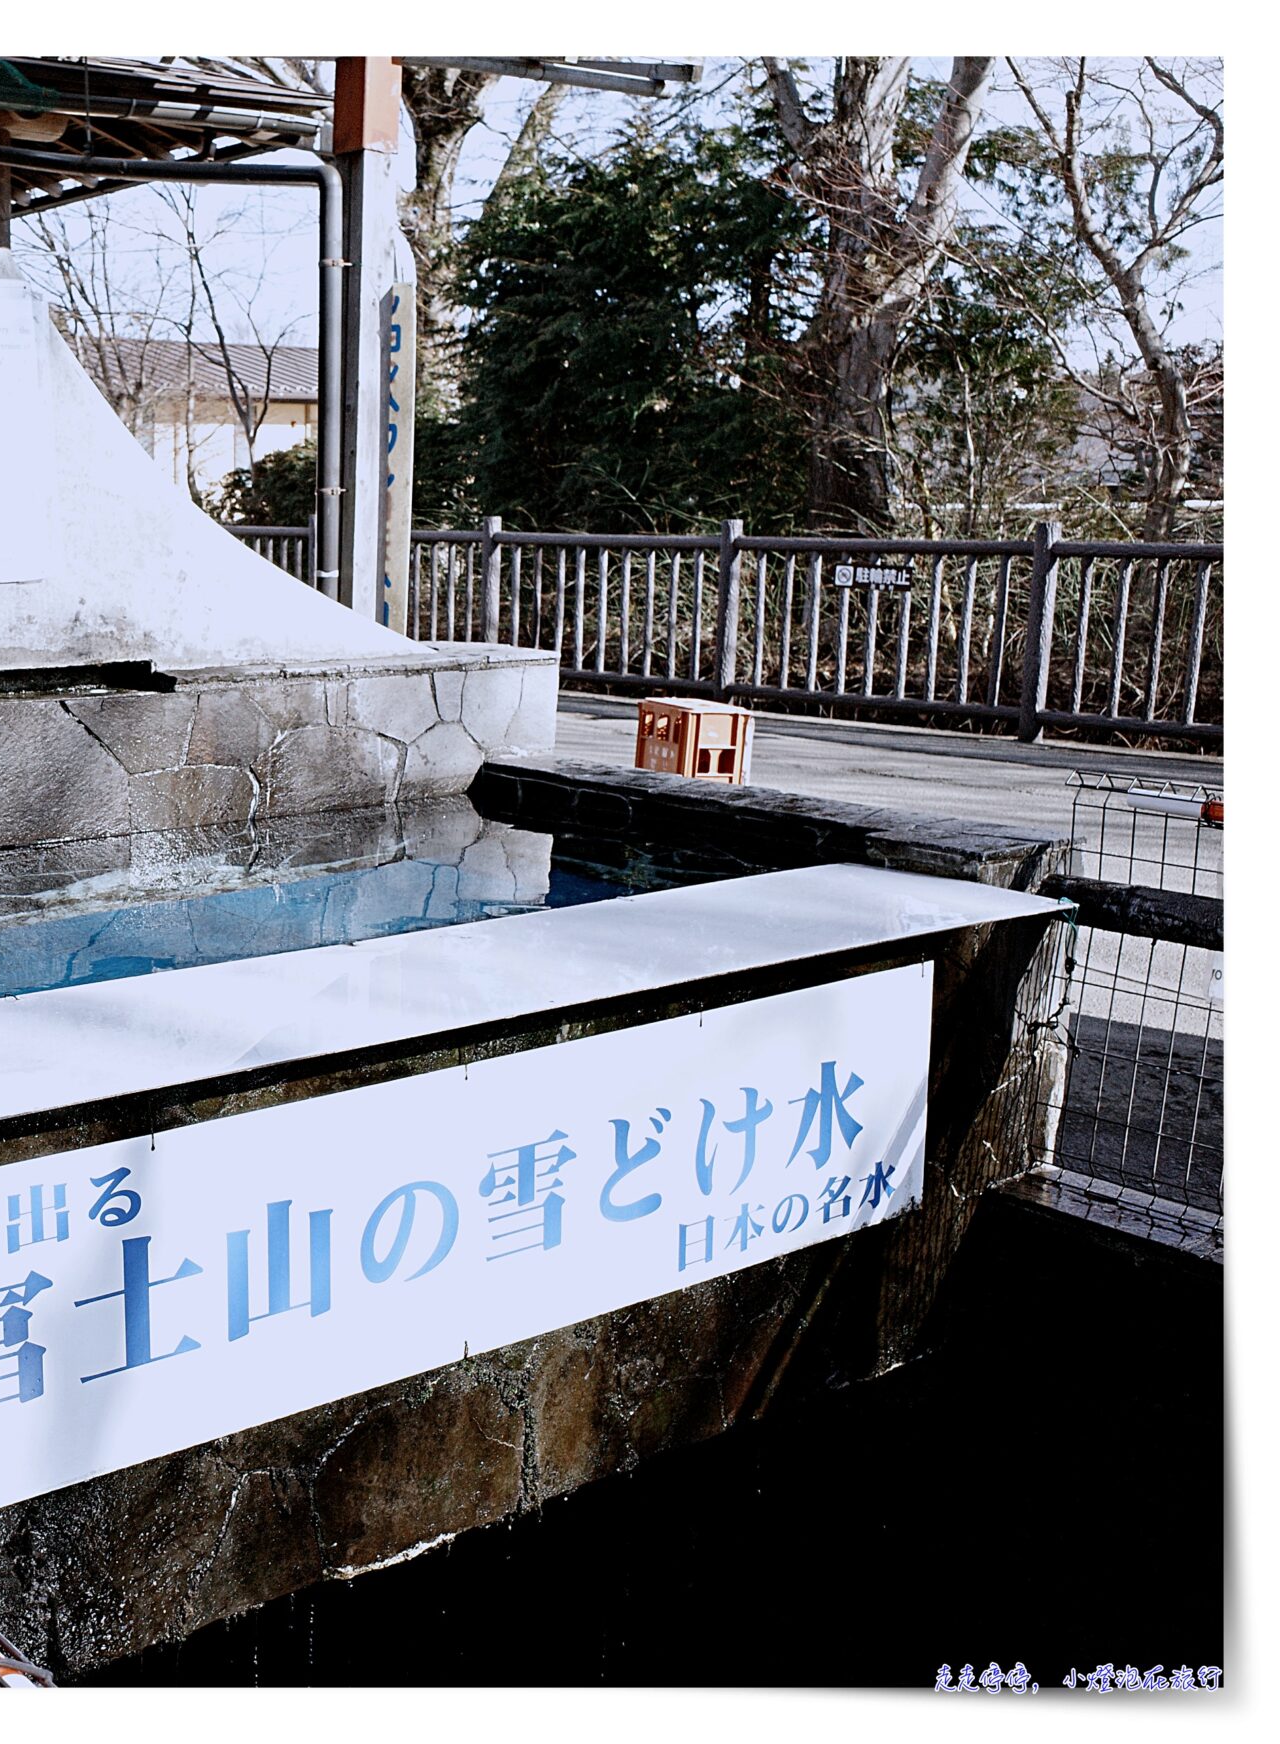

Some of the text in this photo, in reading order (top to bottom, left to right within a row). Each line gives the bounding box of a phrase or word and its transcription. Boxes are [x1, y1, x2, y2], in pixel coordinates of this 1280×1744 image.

[855, 567, 910, 585] 駐輪禁止
[676, 1160, 897, 1273] 日本の名水
